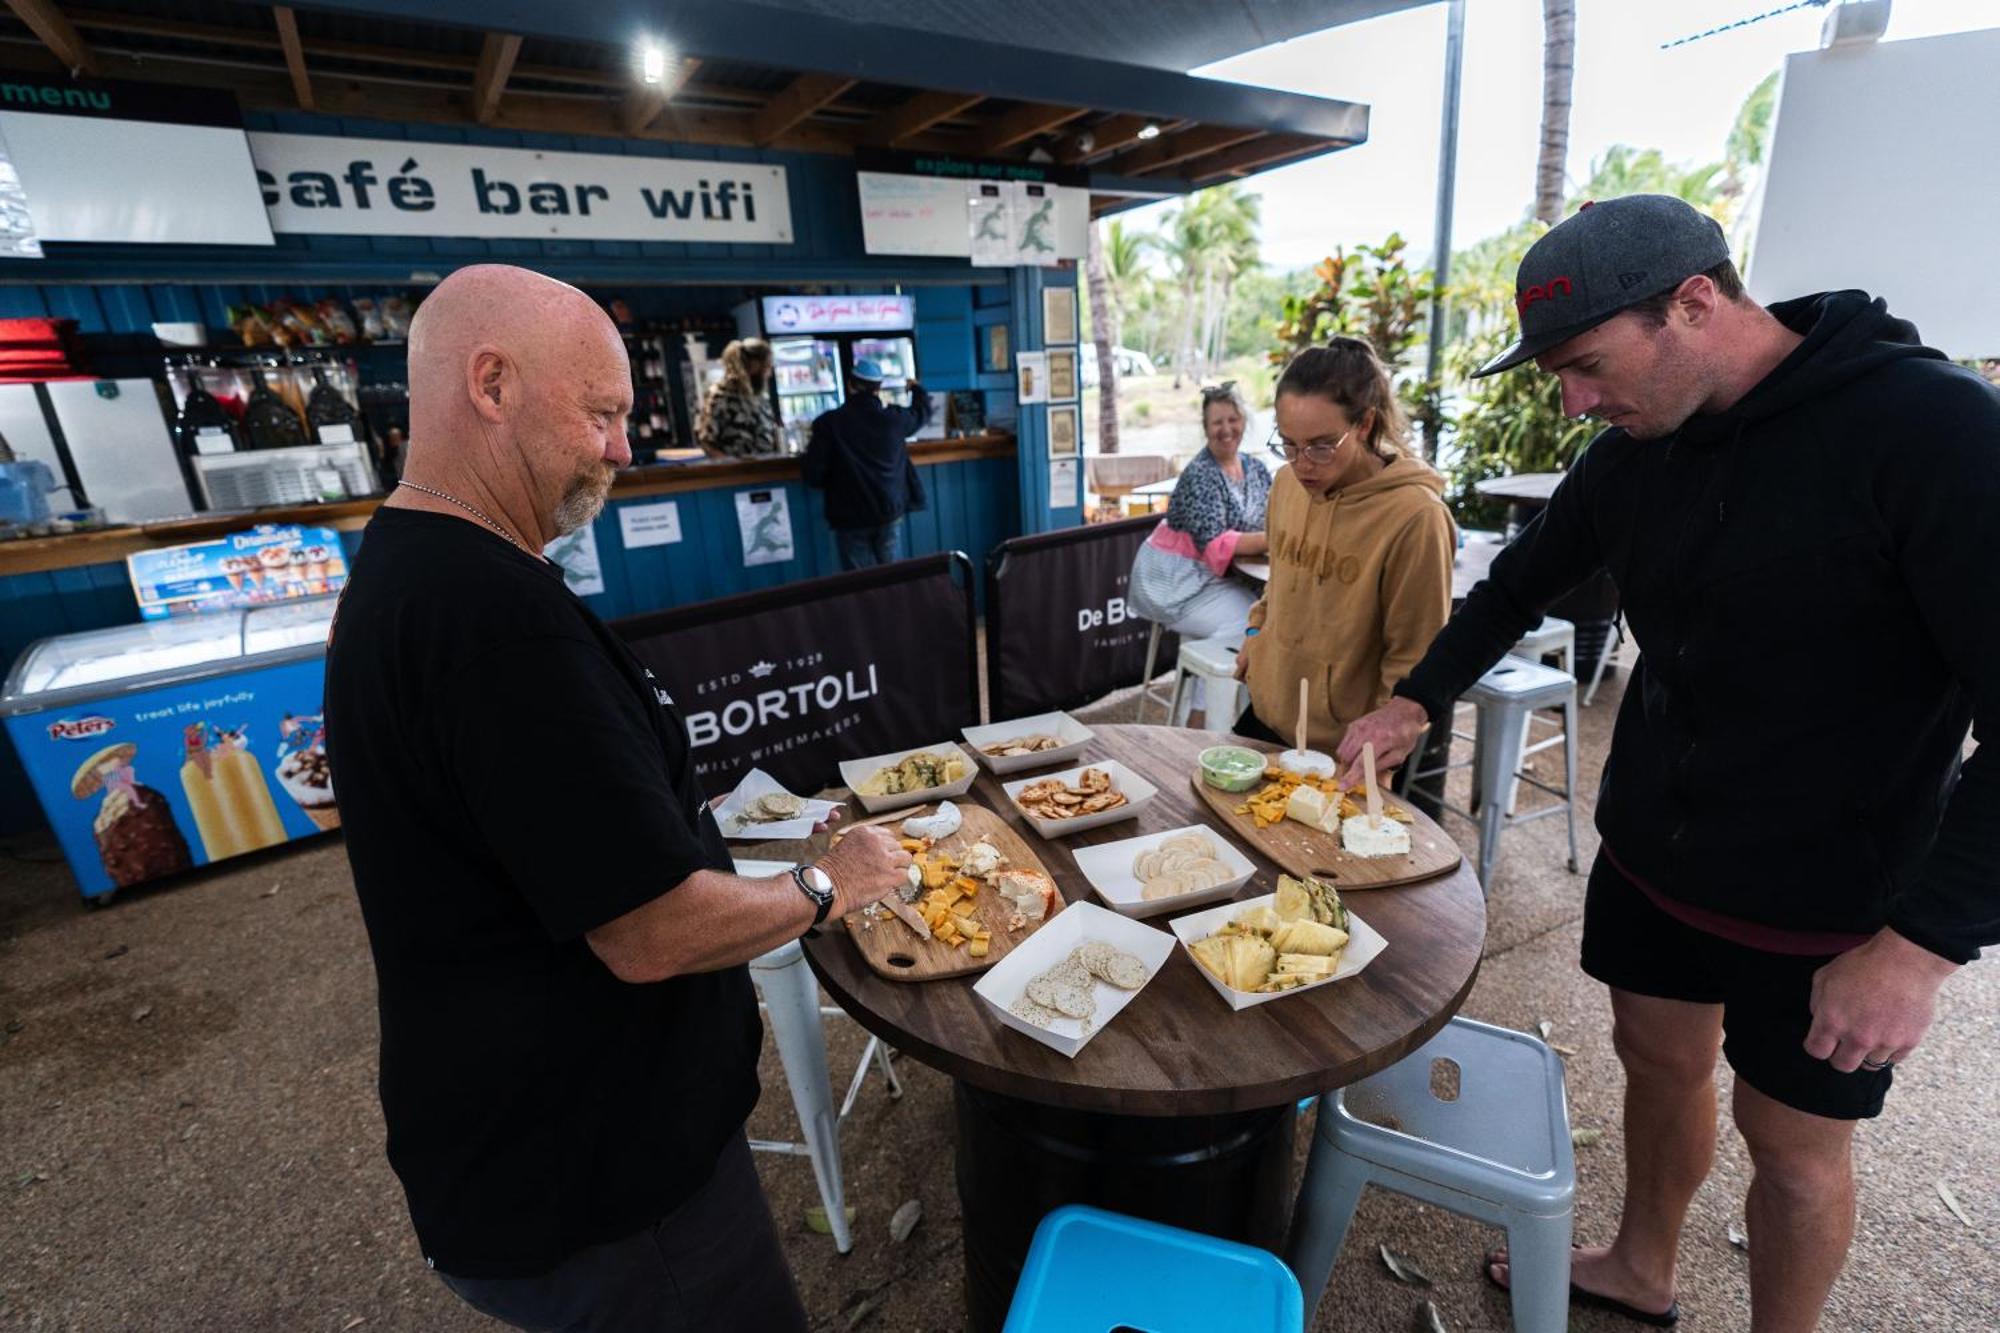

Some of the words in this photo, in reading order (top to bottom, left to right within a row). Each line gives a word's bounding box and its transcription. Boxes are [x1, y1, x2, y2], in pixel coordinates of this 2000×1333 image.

[0, 82, 112, 110] menu
[471, 168, 609, 216] bar
[640, 180, 757, 222] wifi
[1078, 608, 1103, 632] De
[697, 673, 741, 694] ESTD
[786, 652, 822, 670] 1928
[134, 707, 175, 722] treat
[177, 702, 200, 713] life
[204, 690, 255, 710] joyfully
[685, 664, 878, 748] BORTOLI
[693, 757, 741, 775] MILY
[751, 713, 862, 761] WINEMAKERS
